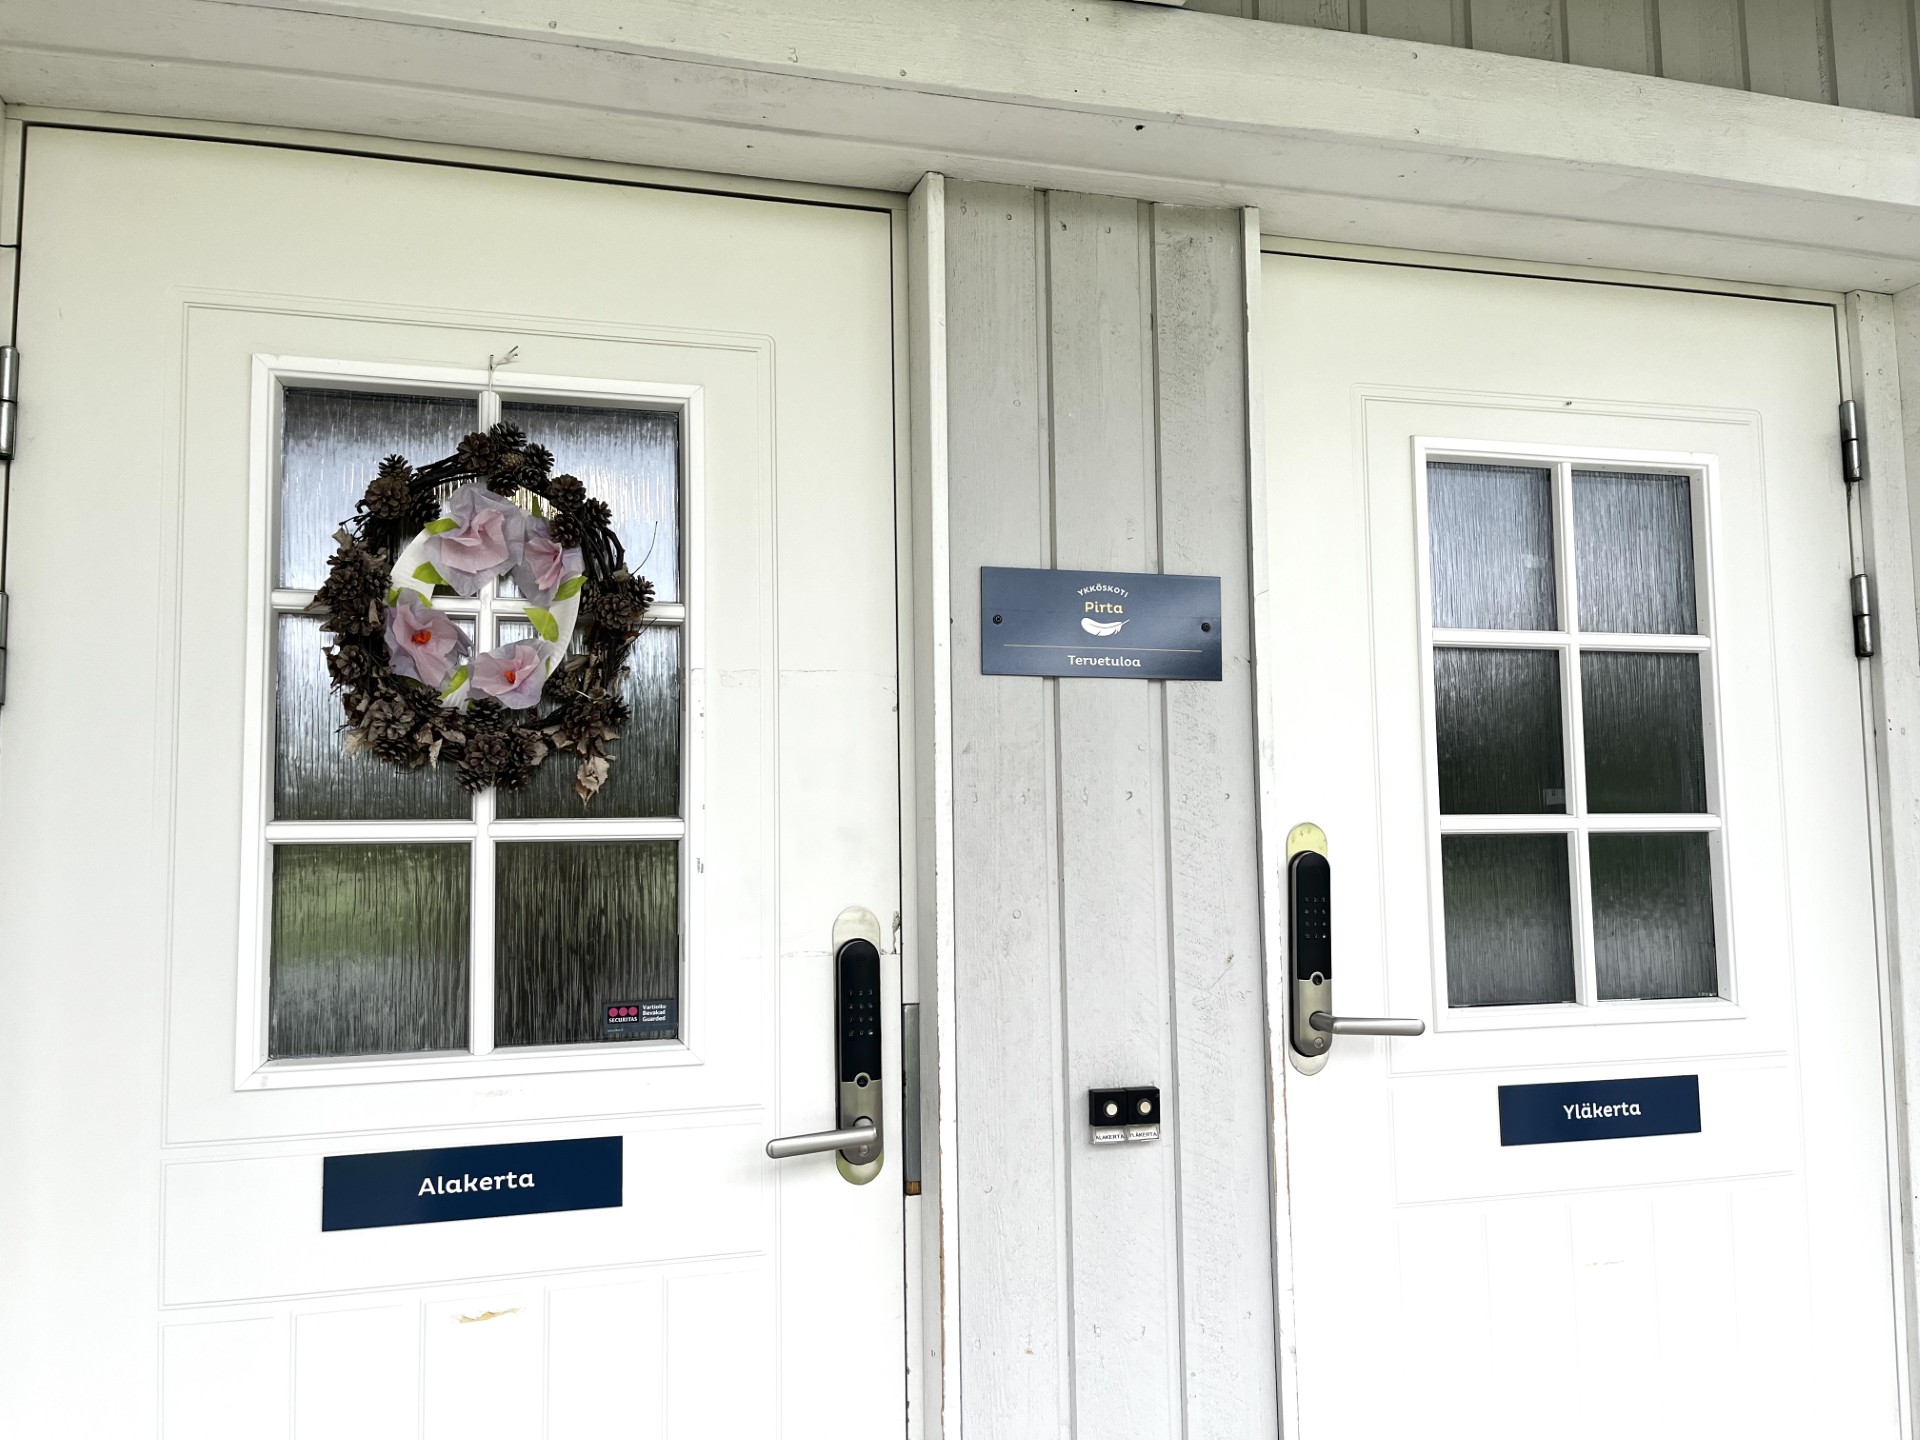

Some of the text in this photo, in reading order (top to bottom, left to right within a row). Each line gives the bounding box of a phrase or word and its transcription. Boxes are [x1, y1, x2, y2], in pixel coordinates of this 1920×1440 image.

[1077, 583, 1129, 598] YKKÖSKOTI
[1084, 601, 1124, 614] Pirta
[1067, 655, 1141, 667] Tervetuloa
[1562, 1101, 1642, 1120] Yläkerta
[417, 1171, 535, 1197] Alakerta
